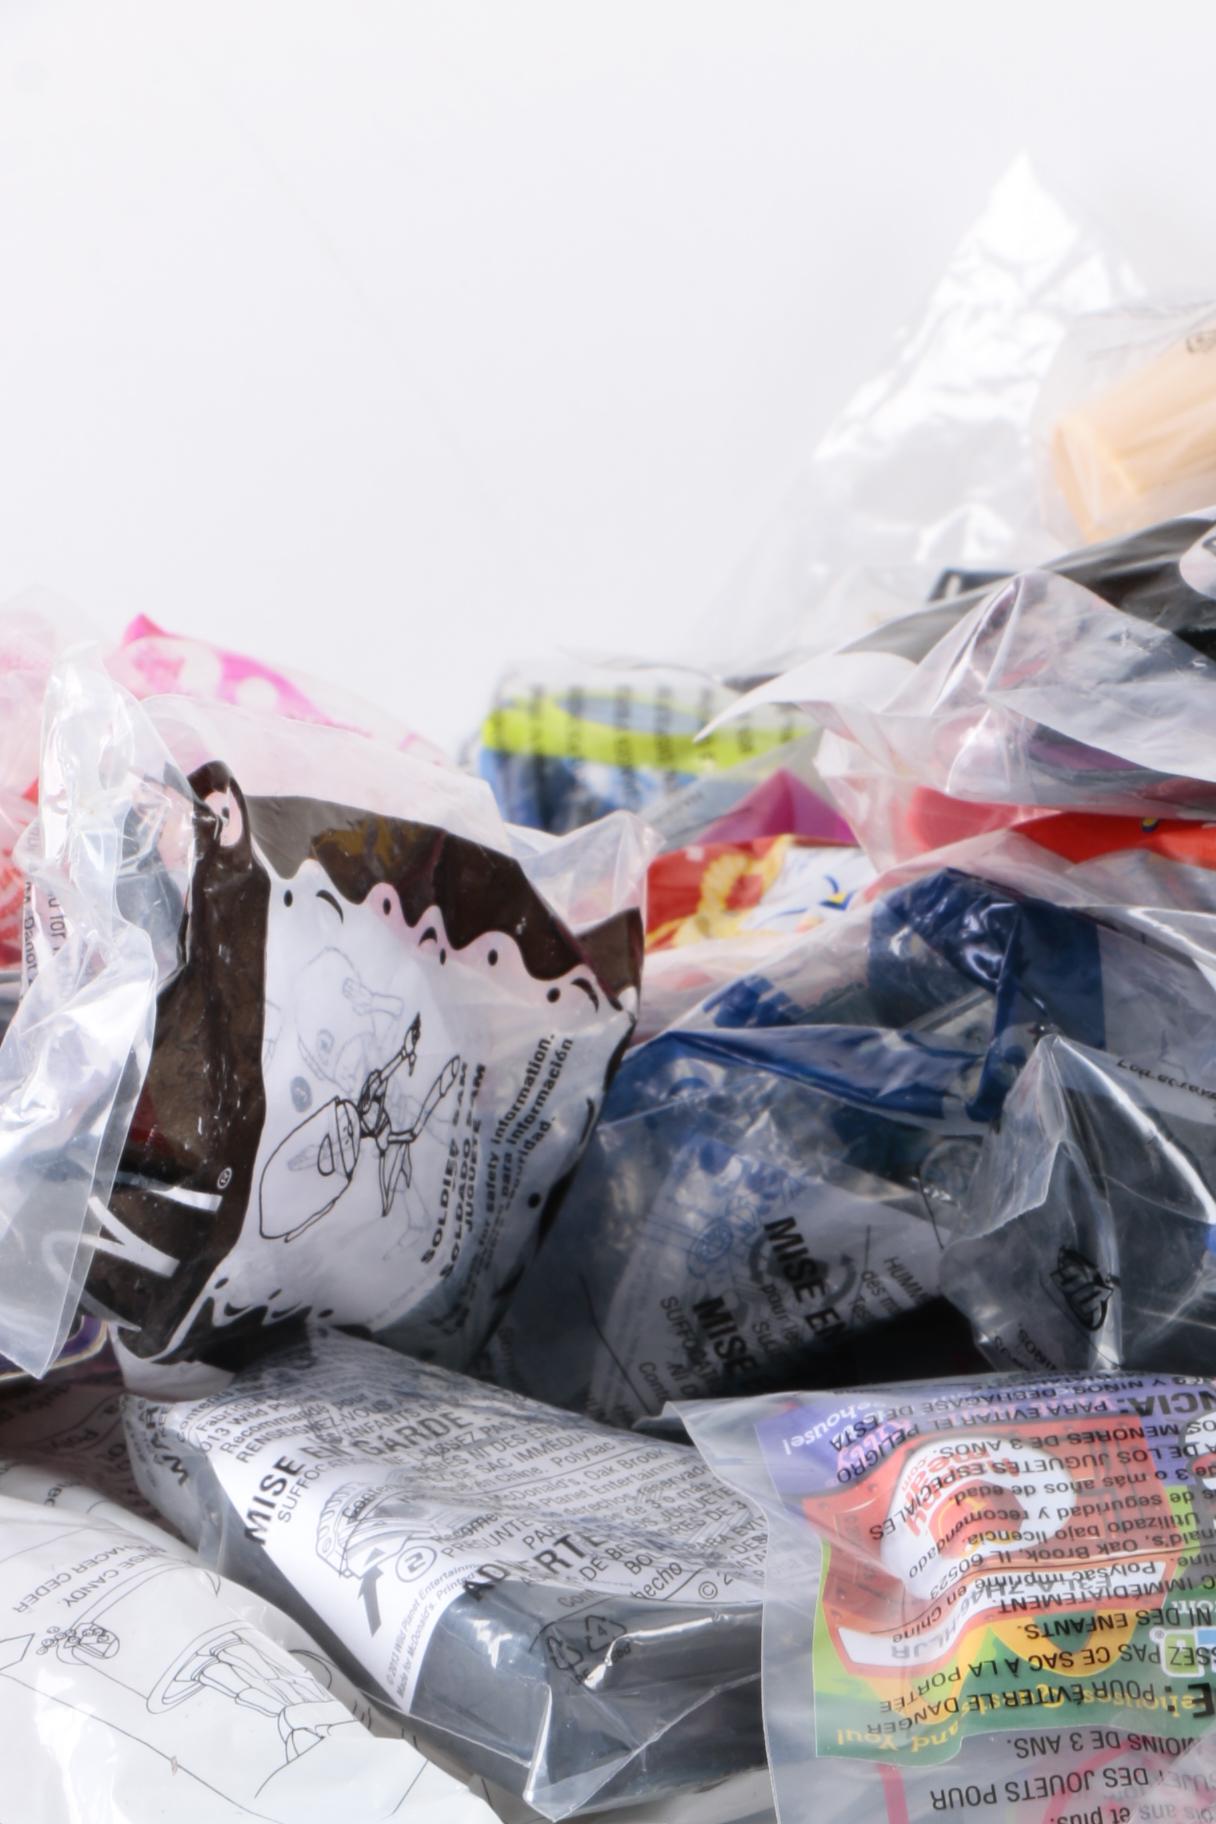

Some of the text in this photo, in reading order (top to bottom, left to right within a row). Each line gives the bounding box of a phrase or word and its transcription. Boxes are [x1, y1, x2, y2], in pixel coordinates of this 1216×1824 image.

[483, 1028, 556, 1146] information.
[503, 1034, 574, 1147] información
[762, 1216, 826, 1306] MISE
[867, 1674, 1154, 1741] POUR ÉVITER LE DANGER
[878, 1641, 1158, 1717] PAS CE SAC À LA PORTÉE
[929, 1764, 1148, 1811] DES JOUETS POUR
